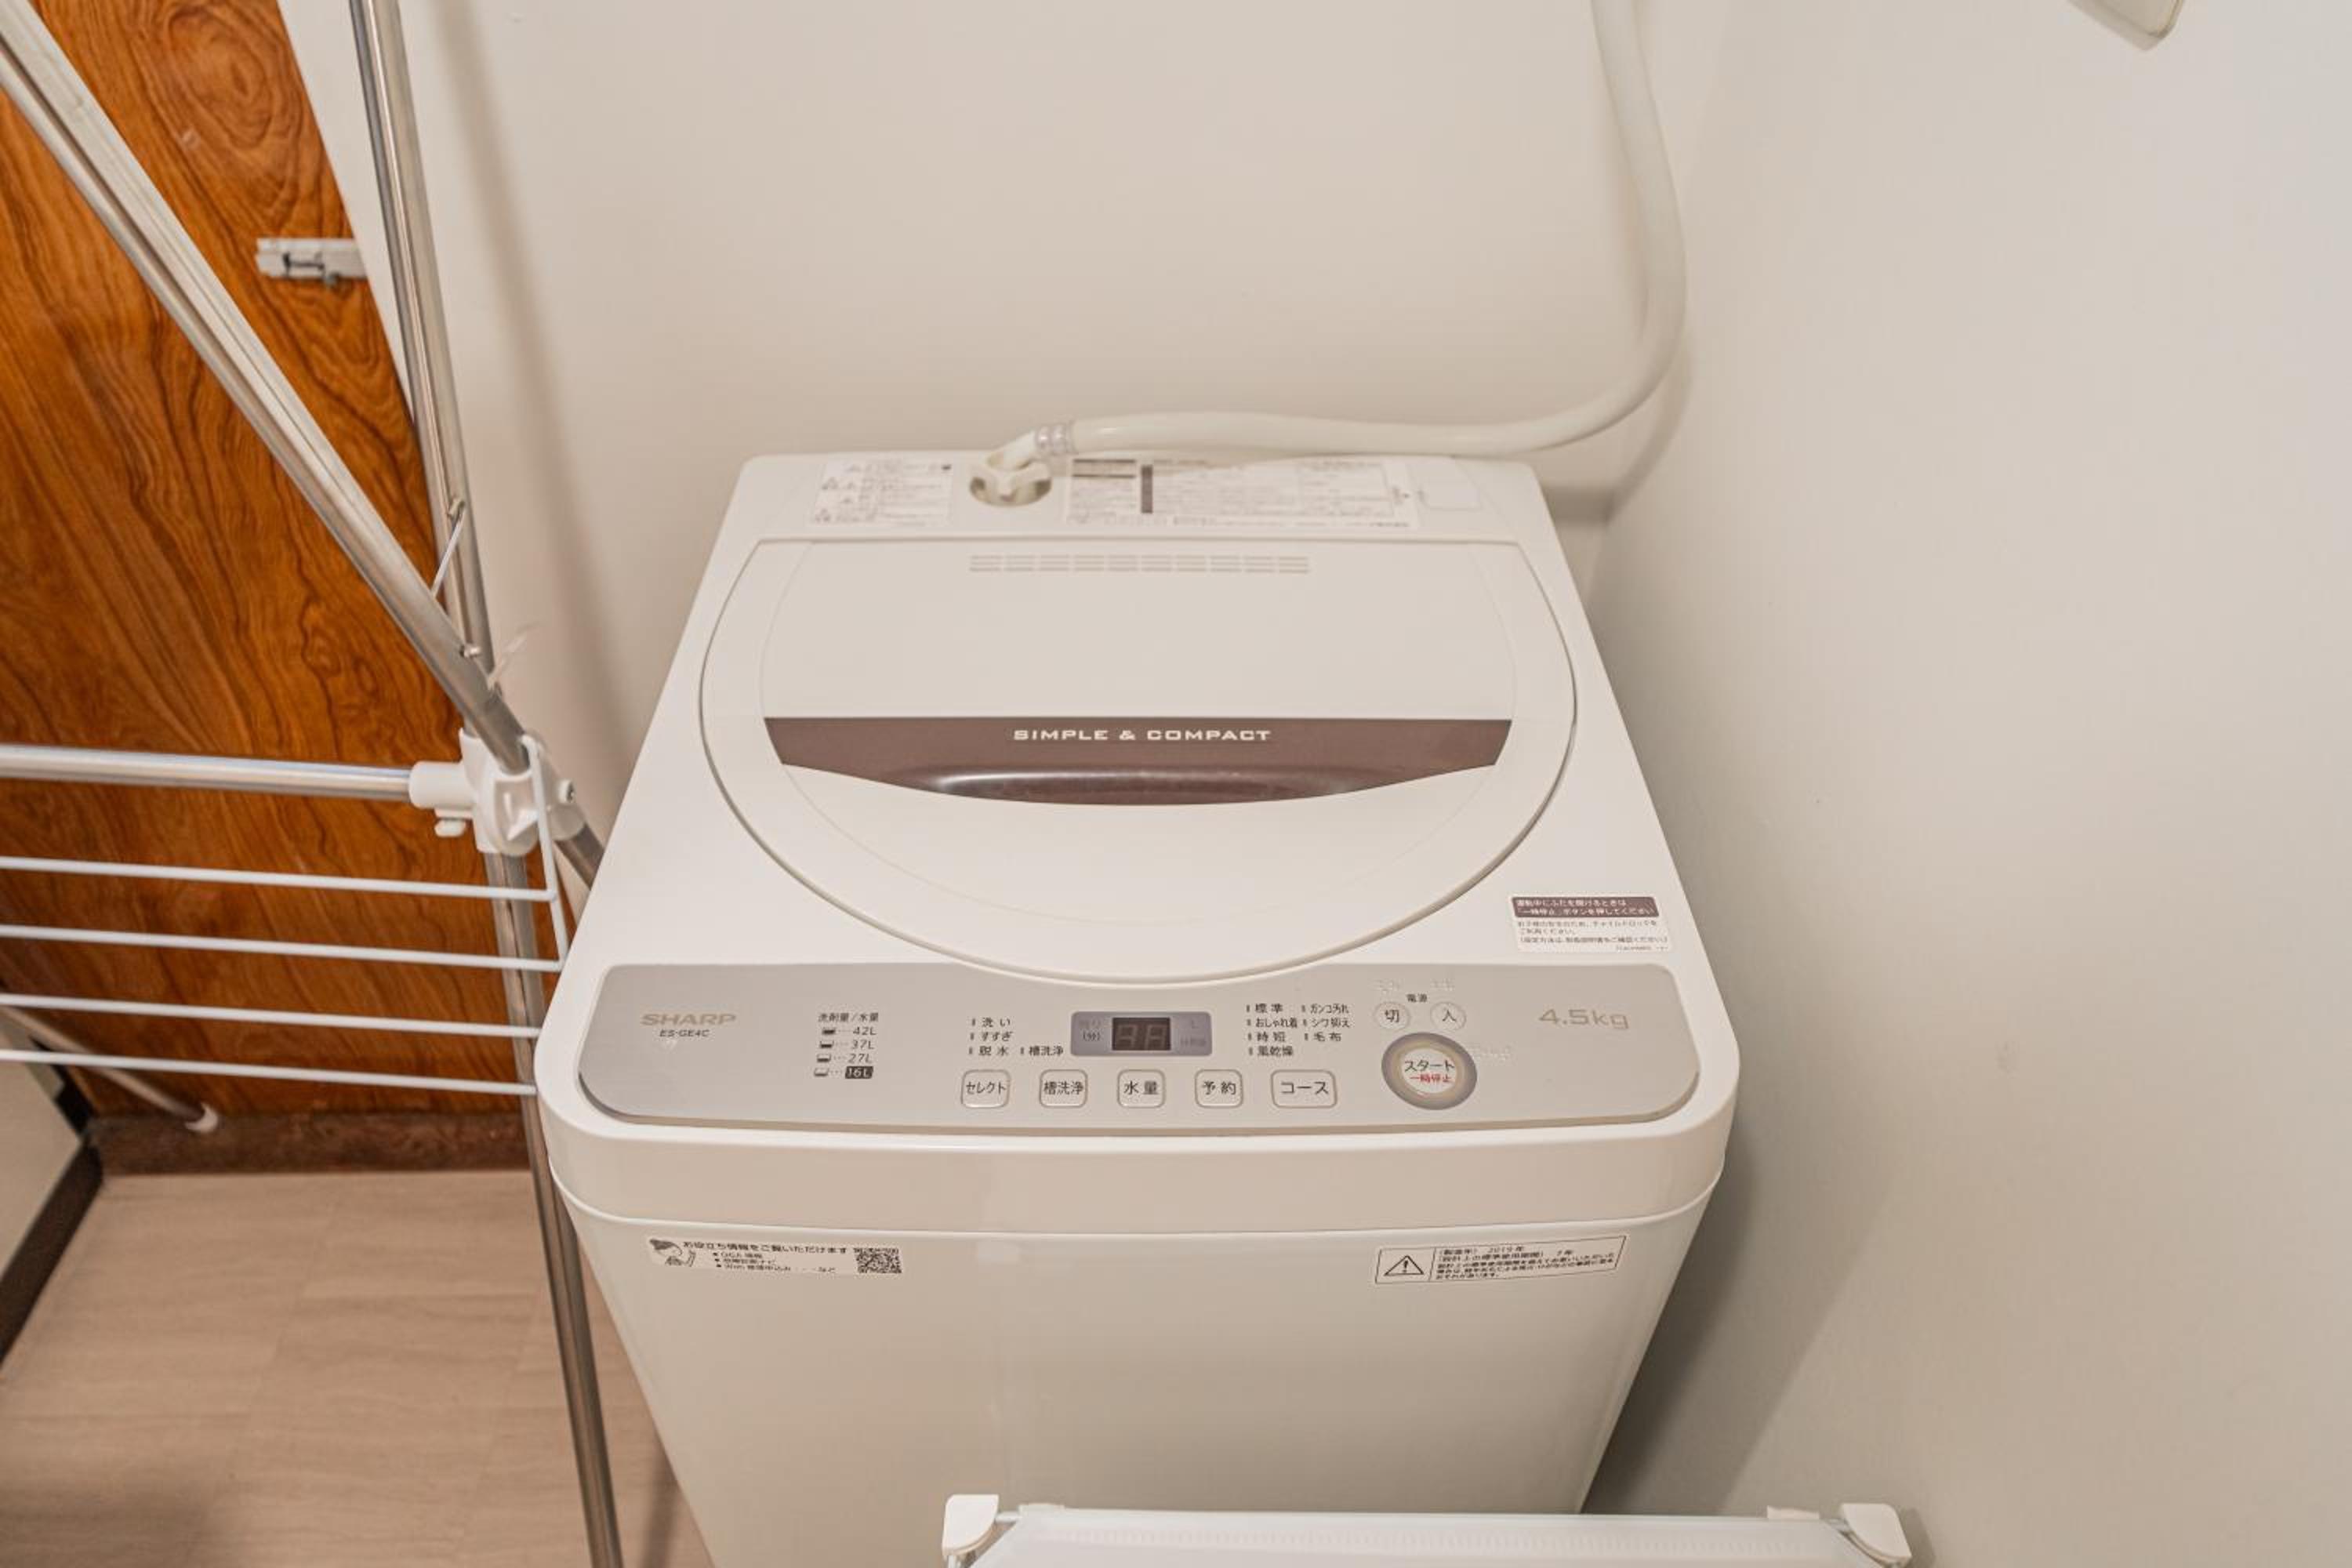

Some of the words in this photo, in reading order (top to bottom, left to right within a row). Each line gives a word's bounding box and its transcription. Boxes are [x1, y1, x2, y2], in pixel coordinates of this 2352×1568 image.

[1014, 729, 1109, 741] SIMPLE
[1119, 729, 1136, 741] &
[1147, 729, 1272, 741] COMPACT
[1406, 993, 1428, 1003] 電源
[1255, 1003, 1283, 1014] 標準
[639, 1014, 736, 1026] SHARP
[1384, 1009, 1400, 1022] 切
[1442, 1009, 1457, 1022] 入
[1537, 1008, 1630, 1030] 4.5kg
[982, 1017, 1011, 1028] 洗い
[1255, 1017, 1298, 1029] おしゃれ着
[1311, 1017, 1351, 1028] シワ抑え
[852, 1025, 877, 1036] 42L
[982, 1030, 1014, 1042] すすぎ
[1257, 1032, 1286, 1043] 時短
[1313, 1032, 1342, 1042] 毛布
[851, 1039, 875, 1050] 37L
[979, 1045, 1009, 1056] 脱水
[1029, 1045, 1065, 1056] 槽洗浄
[1258, 1045, 1294, 1056] 風乾燥
[848, 1053, 873, 1064] 27L
[1404, 1059, 1456, 1072] スタート
[848, 1066, 872, 1078] 16L
[1409, 1073, 1453, 1083] 一時停止
[965, 1080, 1007, 1095] セレクト
[1044, 1080, 1084, 1095] 槽洗浄
[1123, 1080, 1160, 1095] 水量
[1202, 1080, 1237, 1095] 予約
[1280, 1080, 1329, 1094] コース
